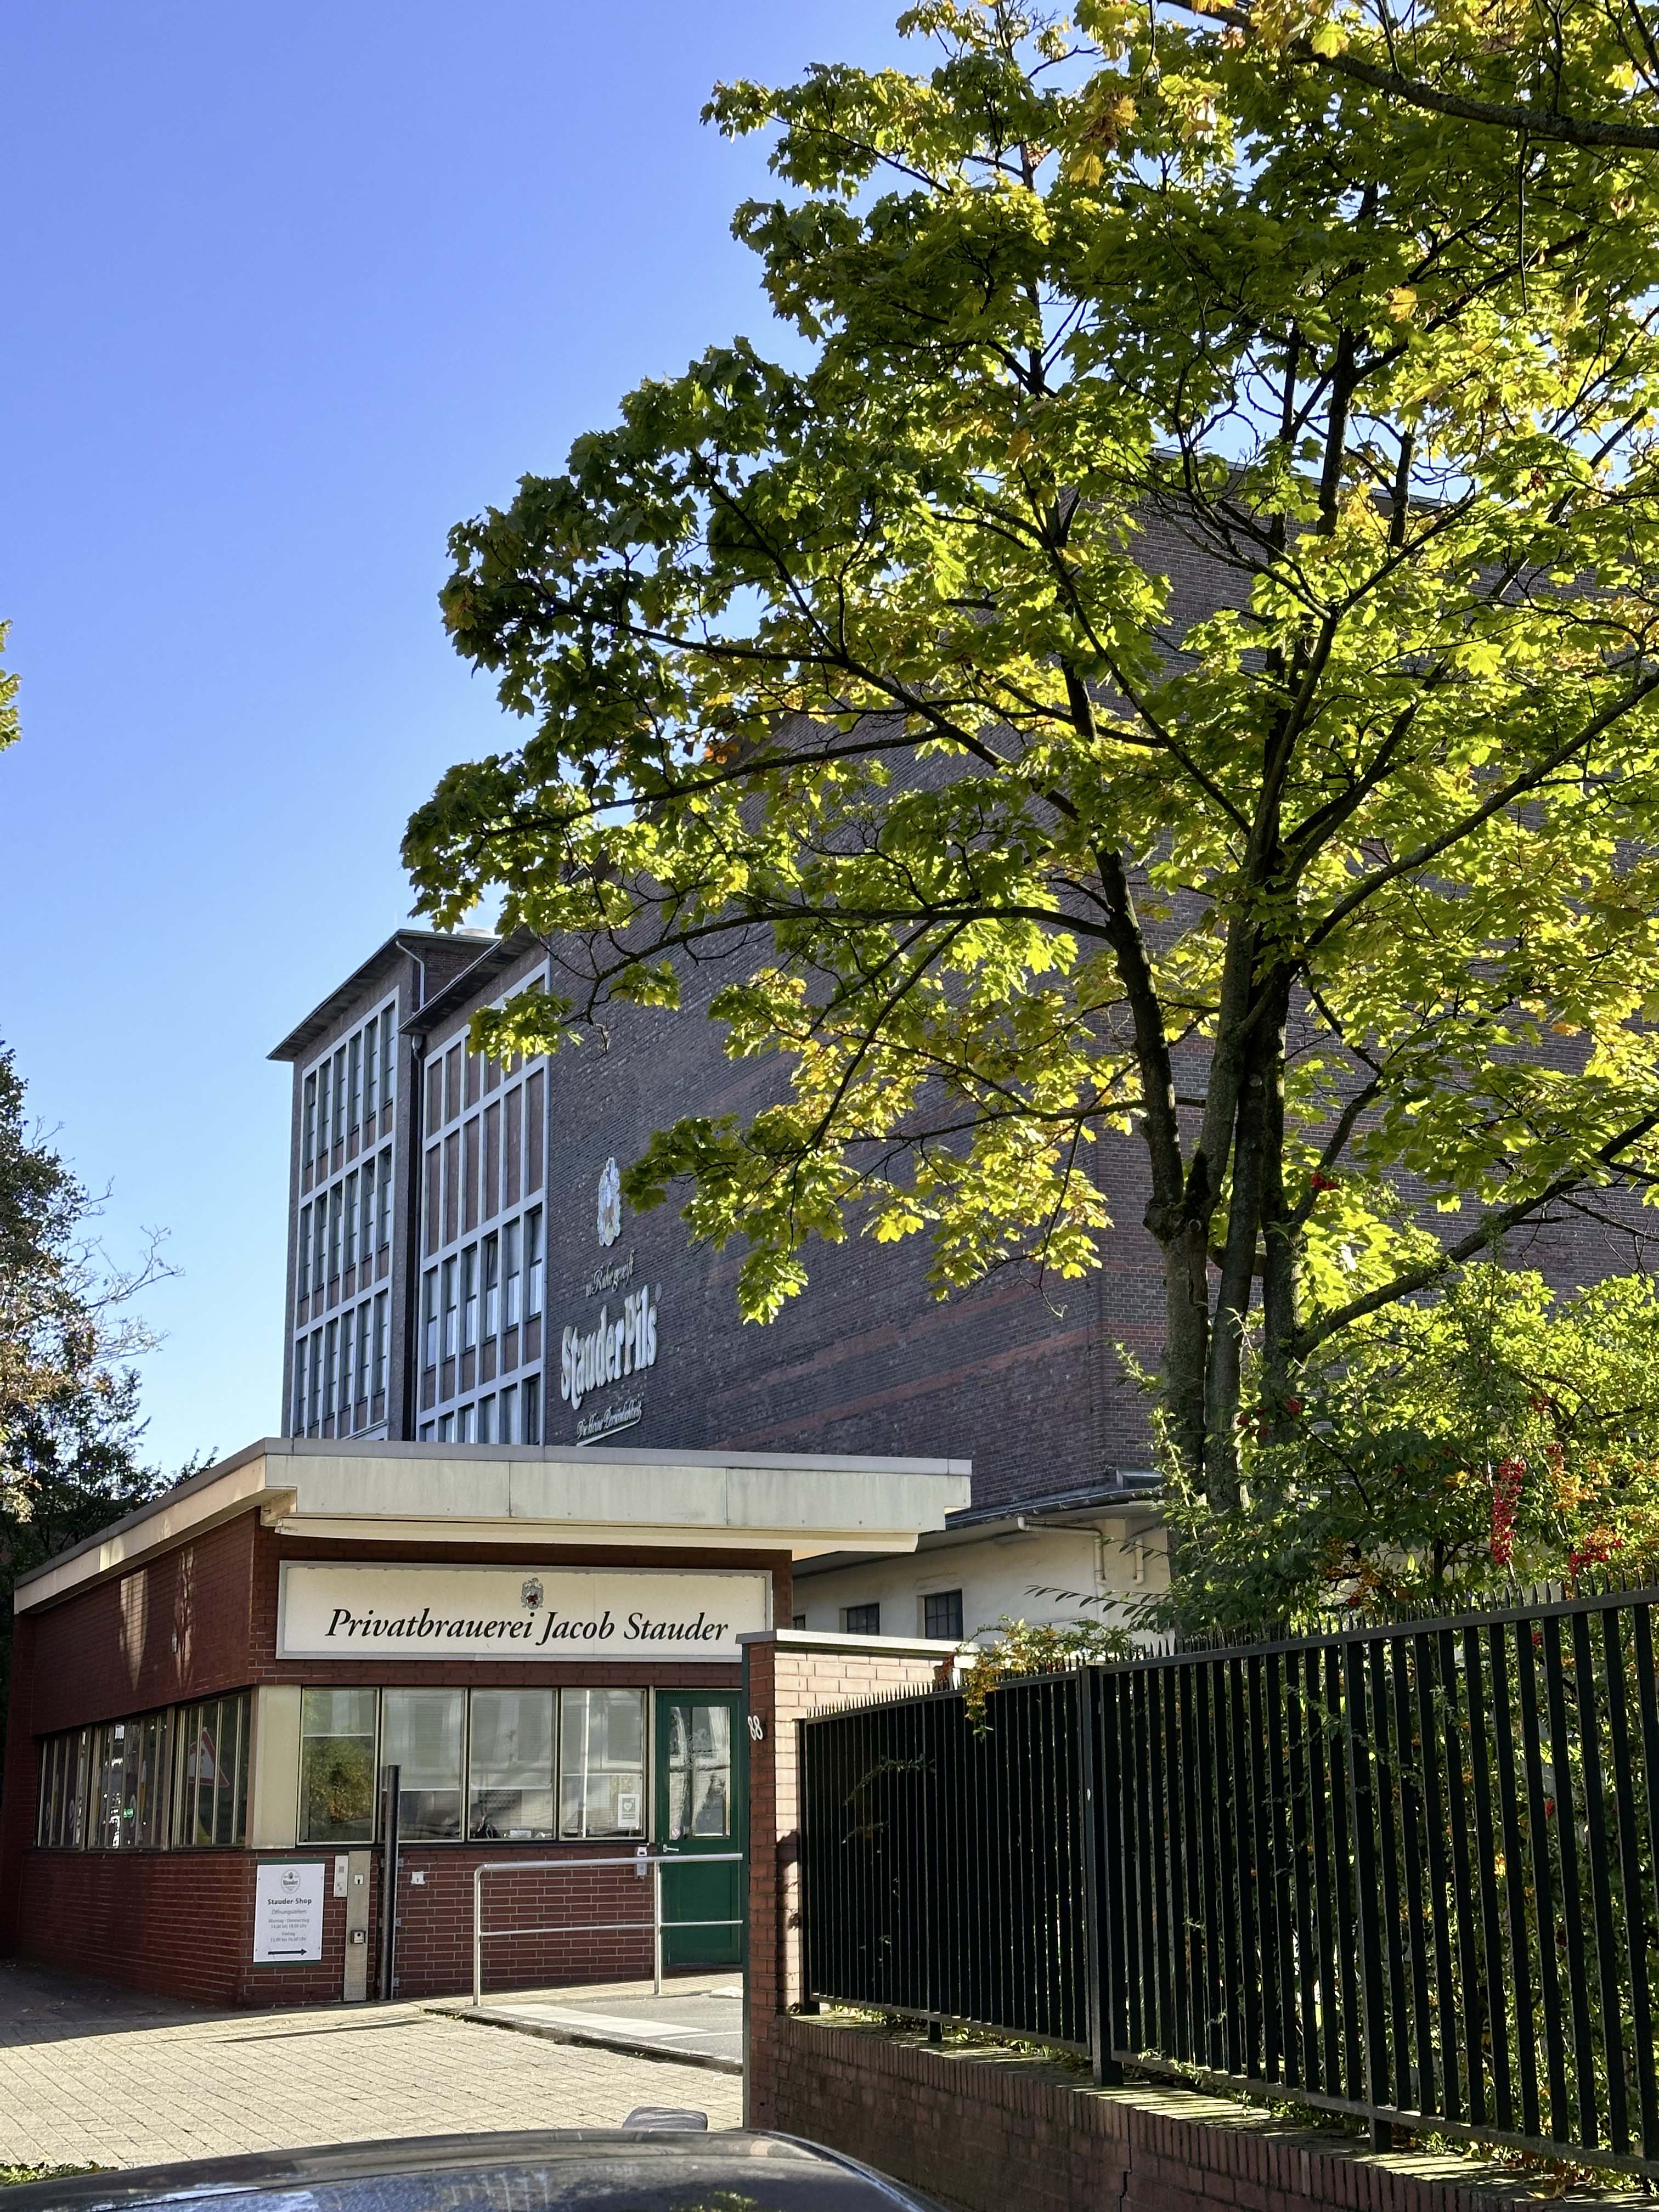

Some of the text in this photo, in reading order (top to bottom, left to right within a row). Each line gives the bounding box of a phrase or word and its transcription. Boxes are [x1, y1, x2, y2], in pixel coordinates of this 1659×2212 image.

[561, 1285, 657, 1410] Stauder Pils
[325, 1608, 728, 1645] Privatbrauerei Jacob Stauder
[748, 1716, 763, 1741] 88
